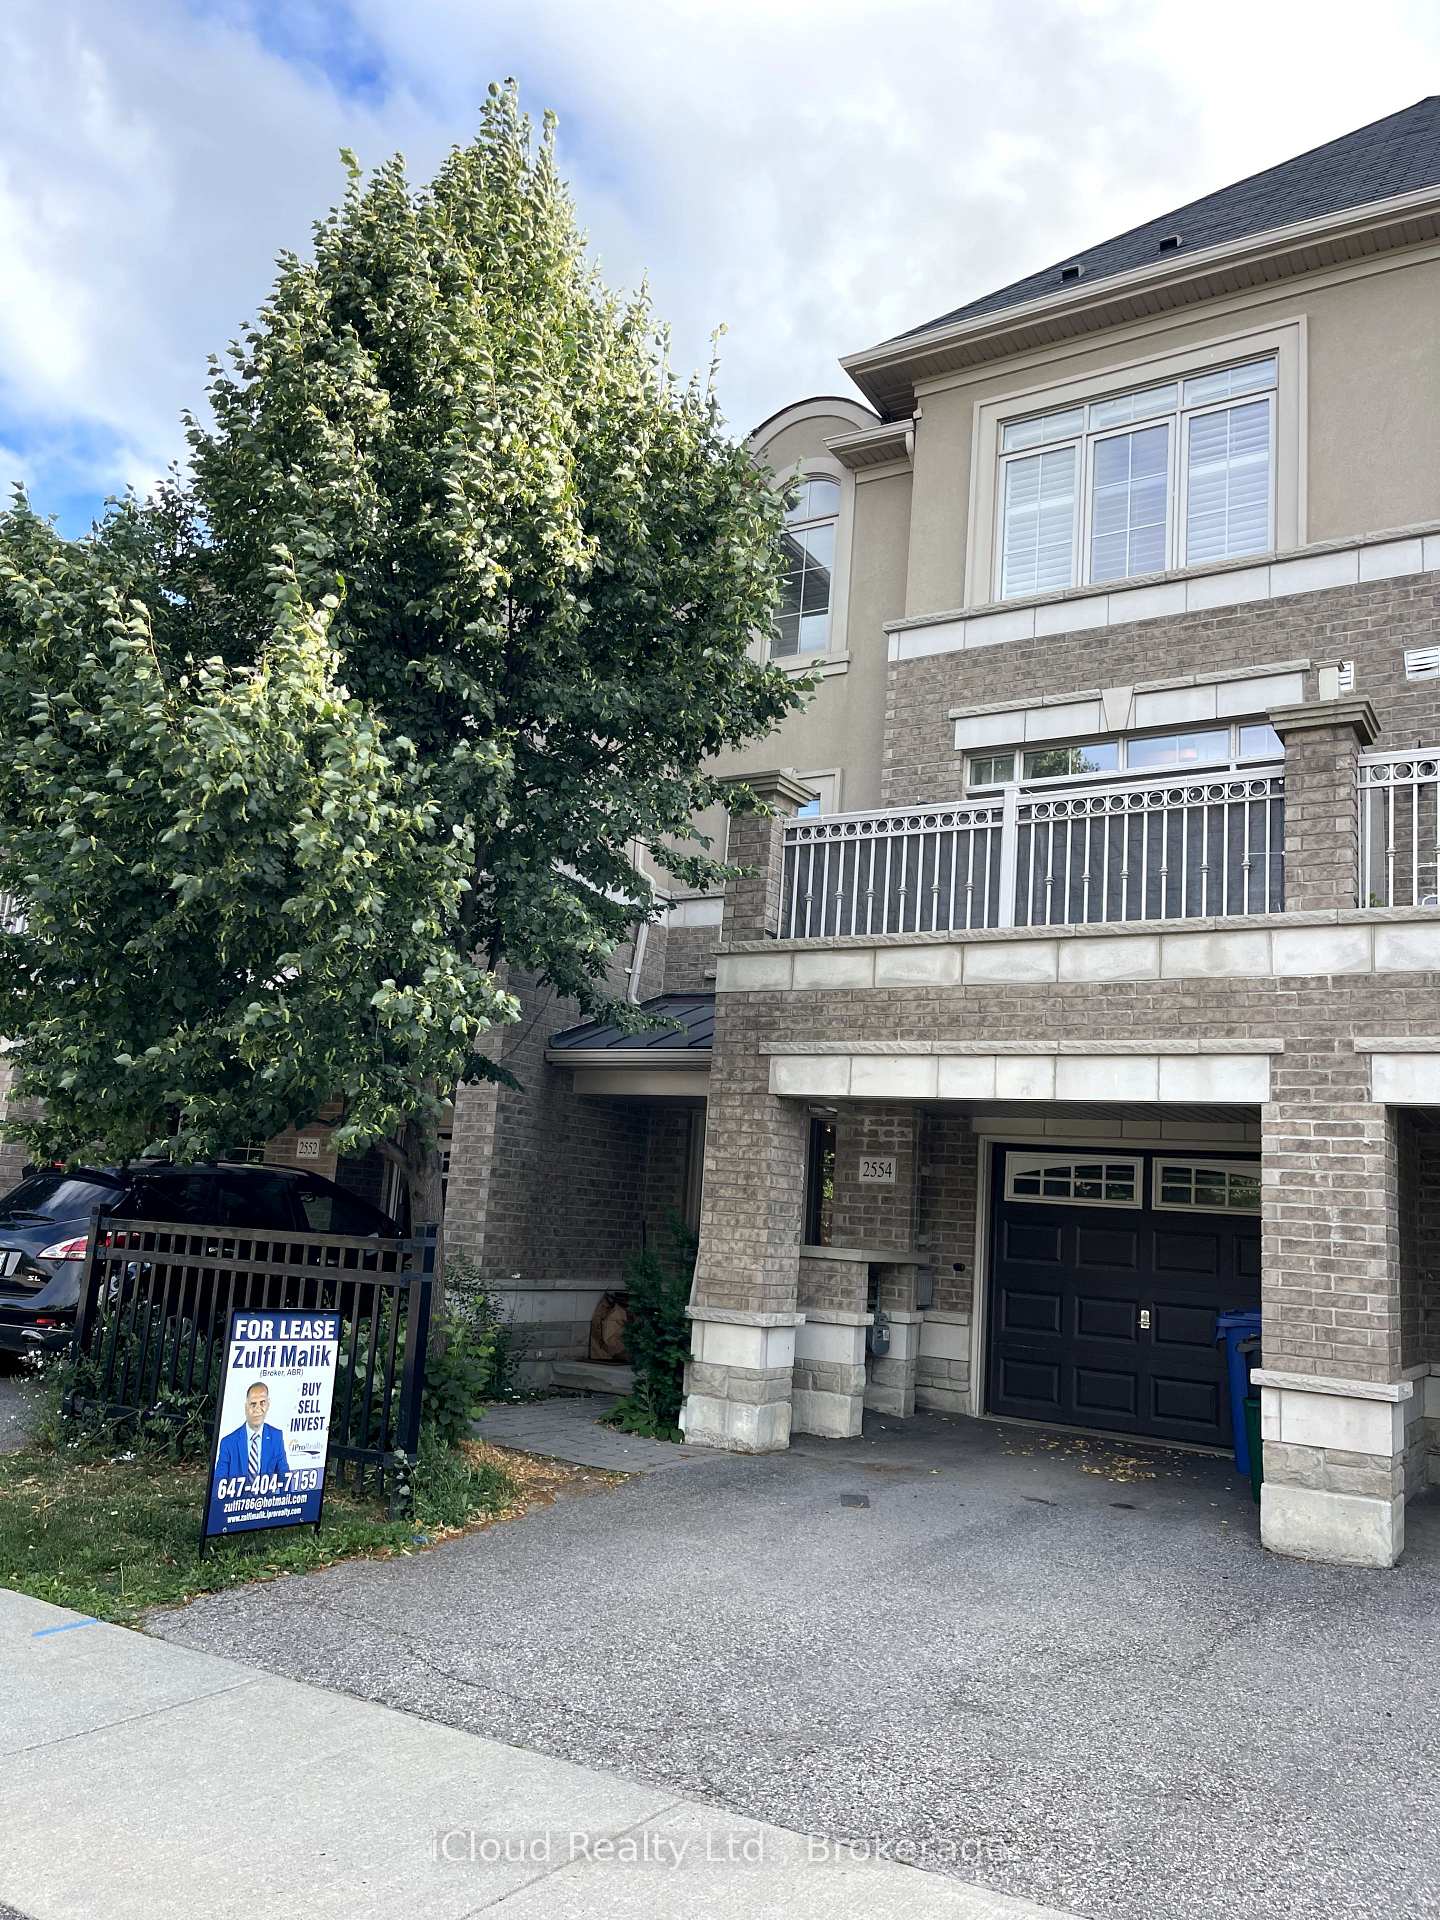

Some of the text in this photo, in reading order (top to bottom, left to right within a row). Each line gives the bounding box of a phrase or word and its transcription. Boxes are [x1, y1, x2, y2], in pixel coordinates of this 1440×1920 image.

[299, 1141, 318, 1155] 2552
[863, 1161, 893, 1178] 2554
[235, 1319, 336, 1340] FOR LEASE
[232, 1344, 331, 1369] Zulfi Malik
[286, 1368, 304, 1378] ABR)
[301, 1382, 322, 1397] BUY
[297, 1399, 321, 1415] SELL
[289, 1416, 326, 1433] INVEST
[217, 1469, 318, 1500] 647-404-7159
[223, 1494, 308, 1513] zulfi786@hotmail.com
